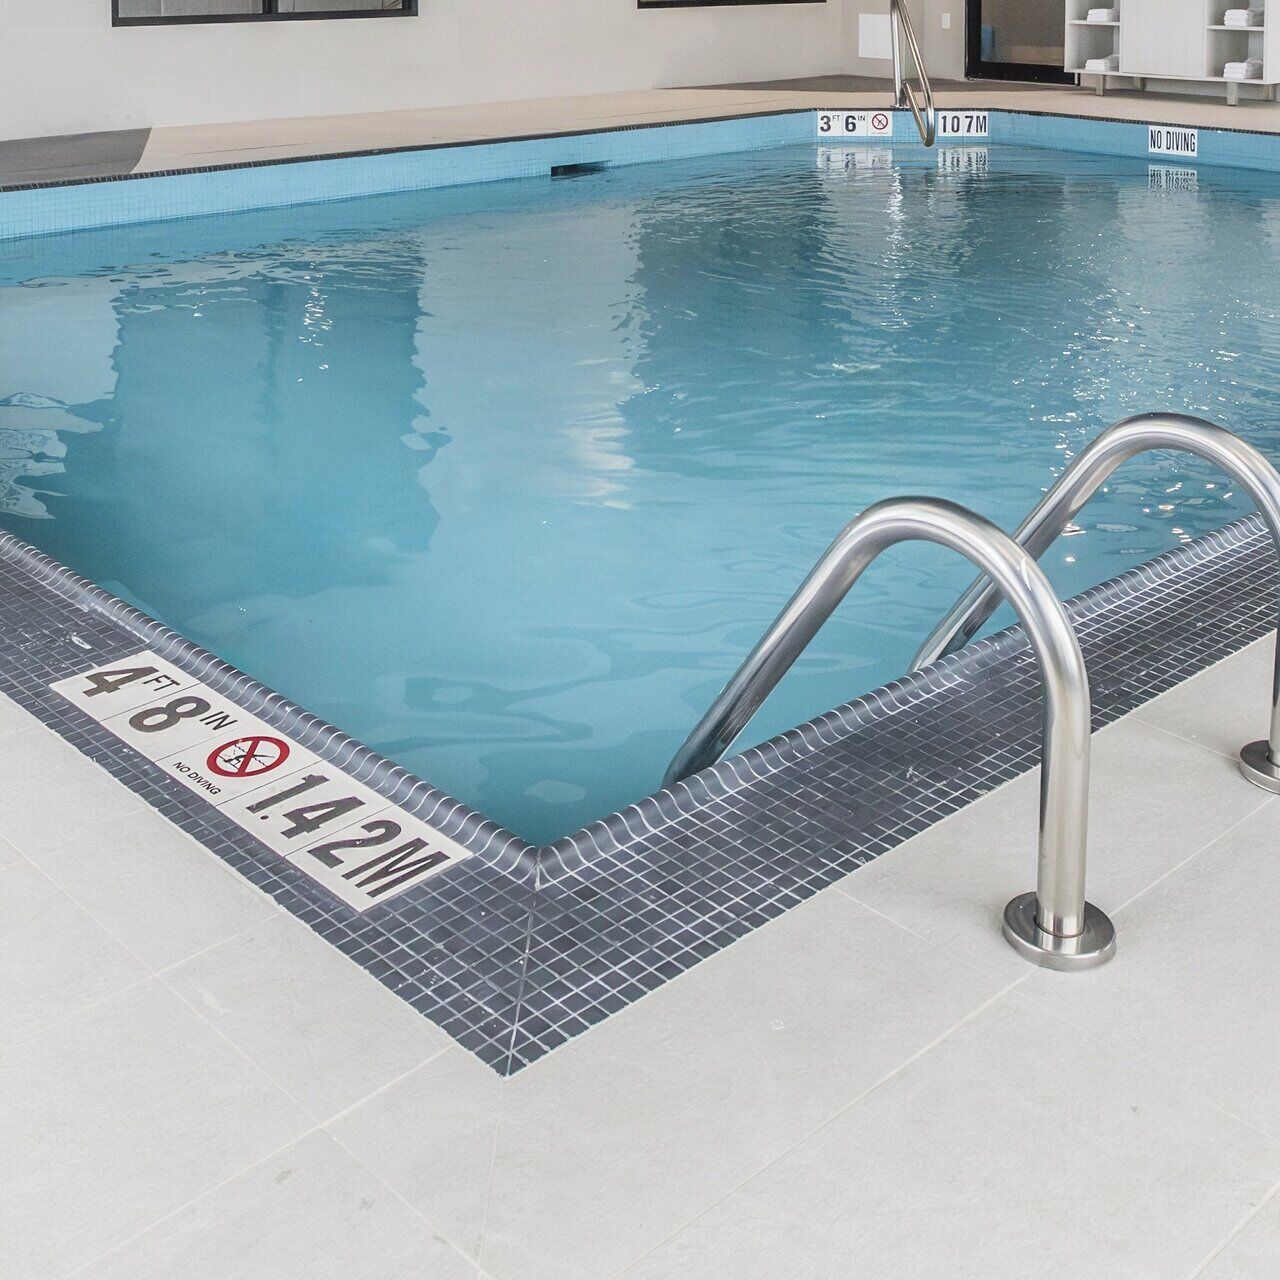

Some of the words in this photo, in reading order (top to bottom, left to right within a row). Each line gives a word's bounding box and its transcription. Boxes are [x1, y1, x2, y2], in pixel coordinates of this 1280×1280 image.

[820, 114, 831, 132] 3
[832, 114, 840, 122] FT
[845, 115, 856, 132] 6
[1150, 129, 1162, 149] NO
[1166, 131, 1196, 152] DIVING
[82, 666, 160, 697] 4
[142, 673, 181, 692] FT
[128, 695, 212, 733] 8
[199, 711, 238, 731] IN
[172, 761, 191, 773] NO
[187, 772, 221, 795] DIVING
